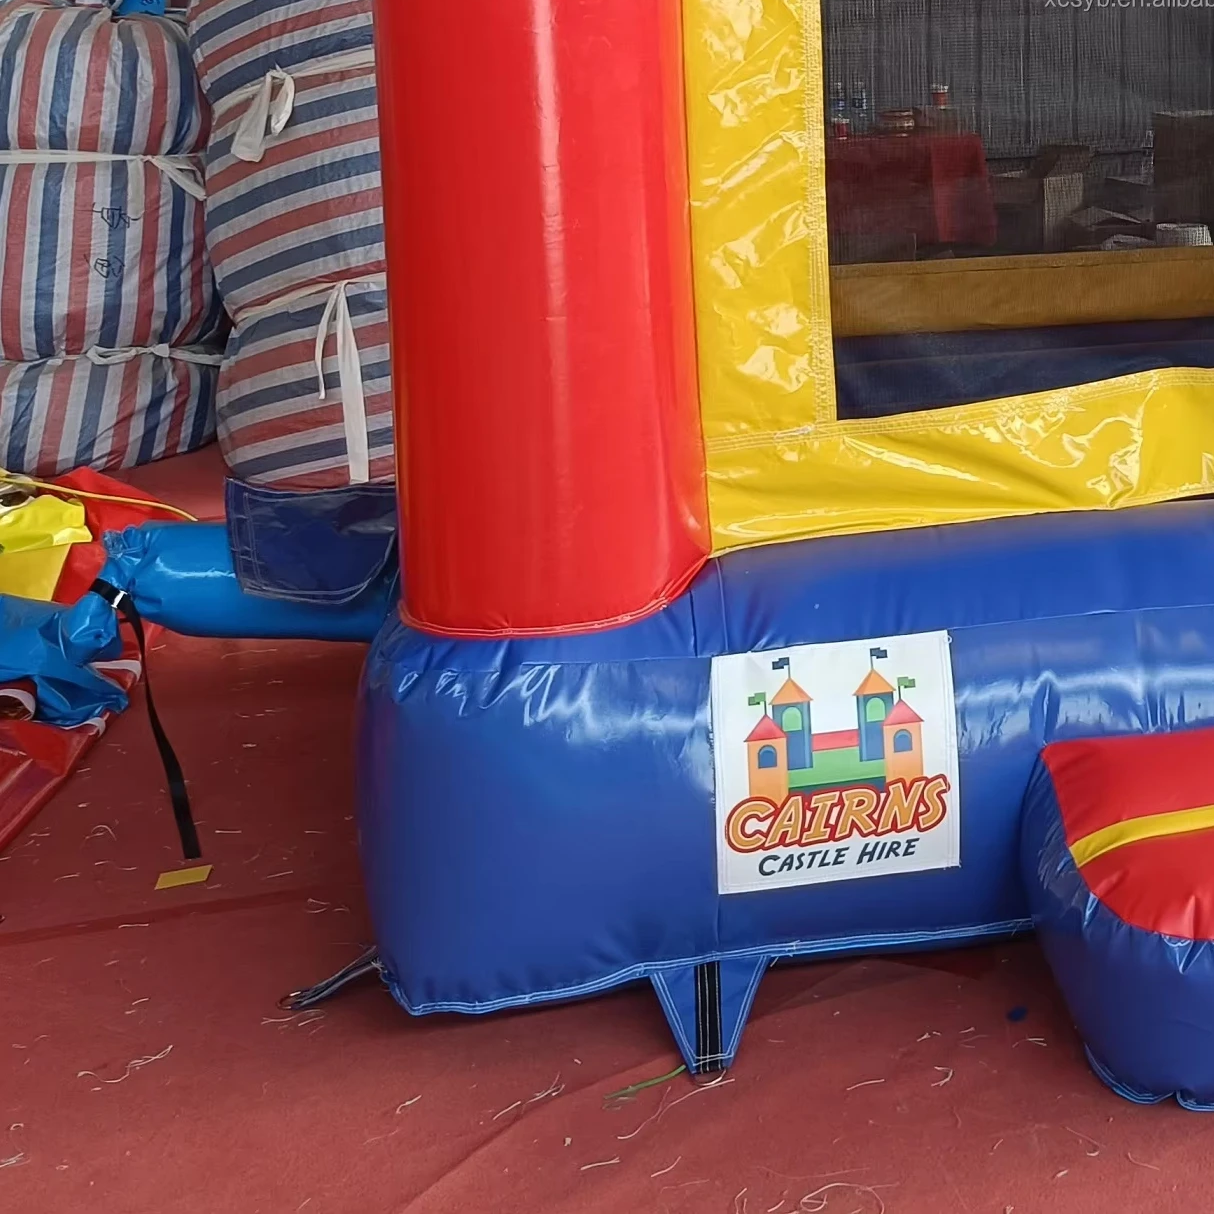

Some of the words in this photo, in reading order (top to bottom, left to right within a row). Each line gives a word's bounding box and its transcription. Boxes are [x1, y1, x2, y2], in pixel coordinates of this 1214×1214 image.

[727, 774, 950, 853] CAIRNS
[758, 847, 849, 876] CASTLE
[856, 838, 920, 865] HIRE
